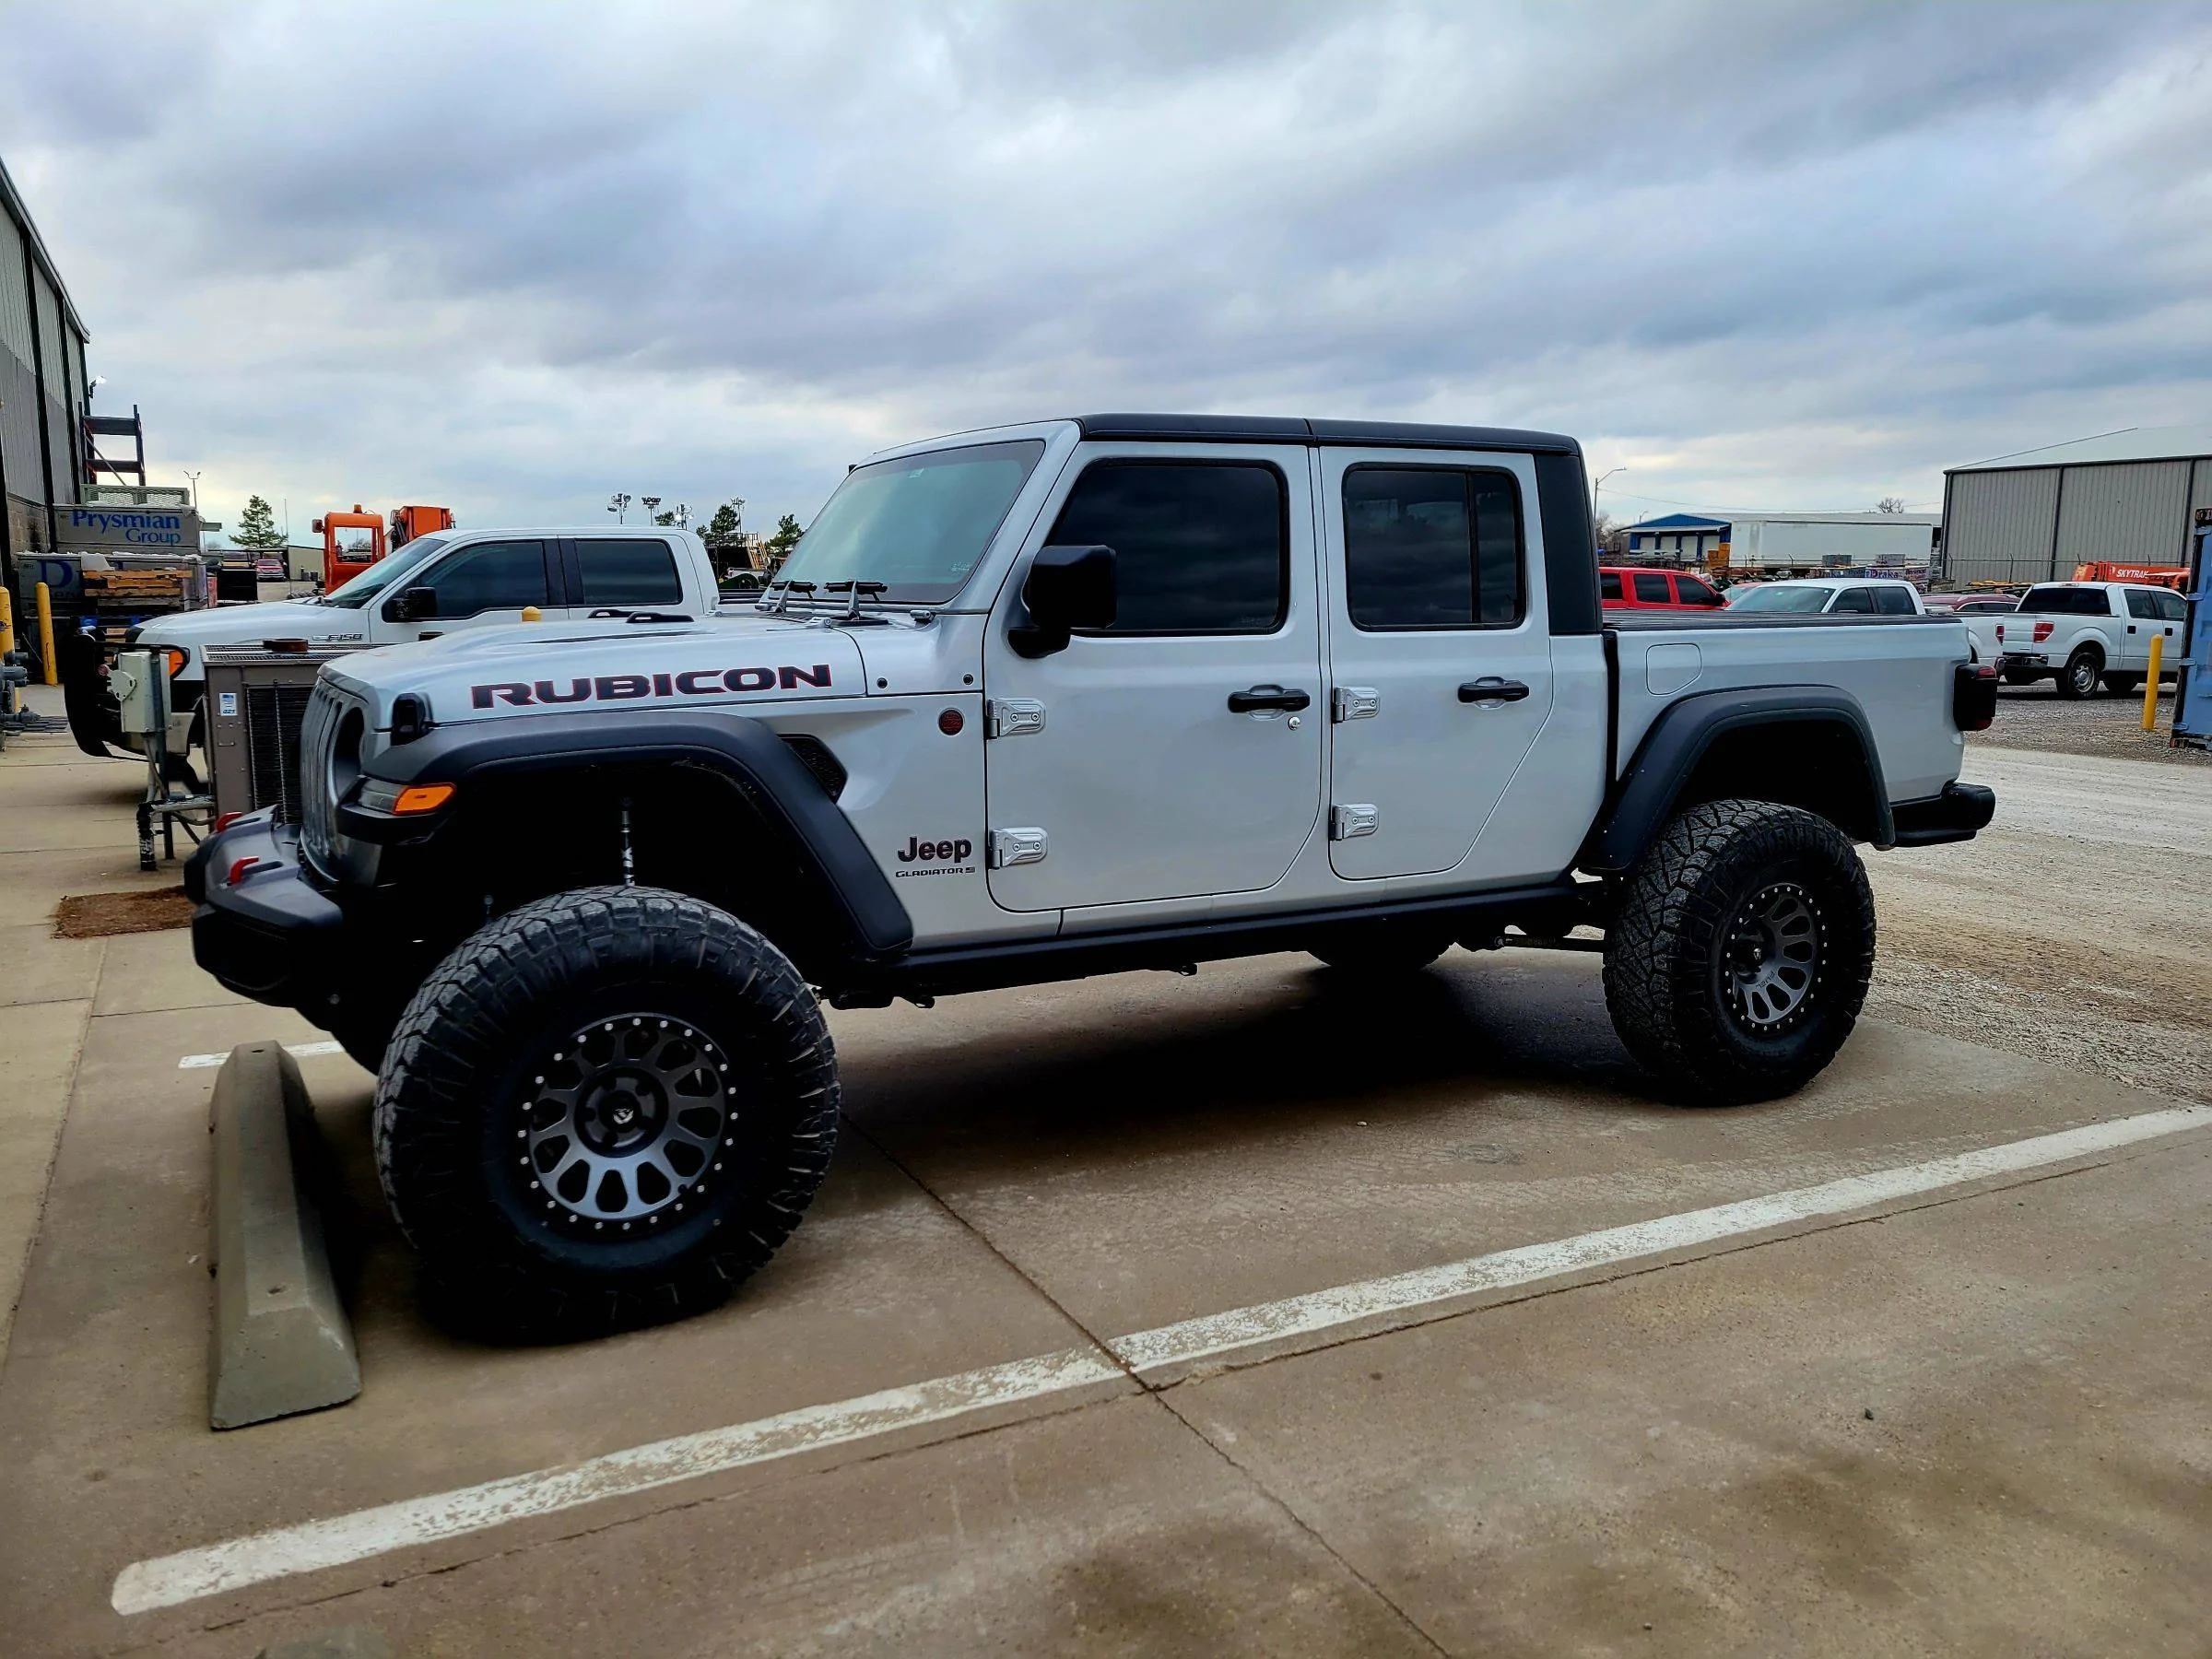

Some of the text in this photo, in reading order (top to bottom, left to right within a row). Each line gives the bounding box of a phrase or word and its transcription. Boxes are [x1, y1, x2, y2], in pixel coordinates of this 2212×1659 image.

[72, 509, 180, 534] Prysmian
[125, 528, 181, 546] Group
[471, 664, 832, 709] RUBICON
[897, 836, 972, 864] Jeep
[895, 867, 964, 878] GLADIATOR
